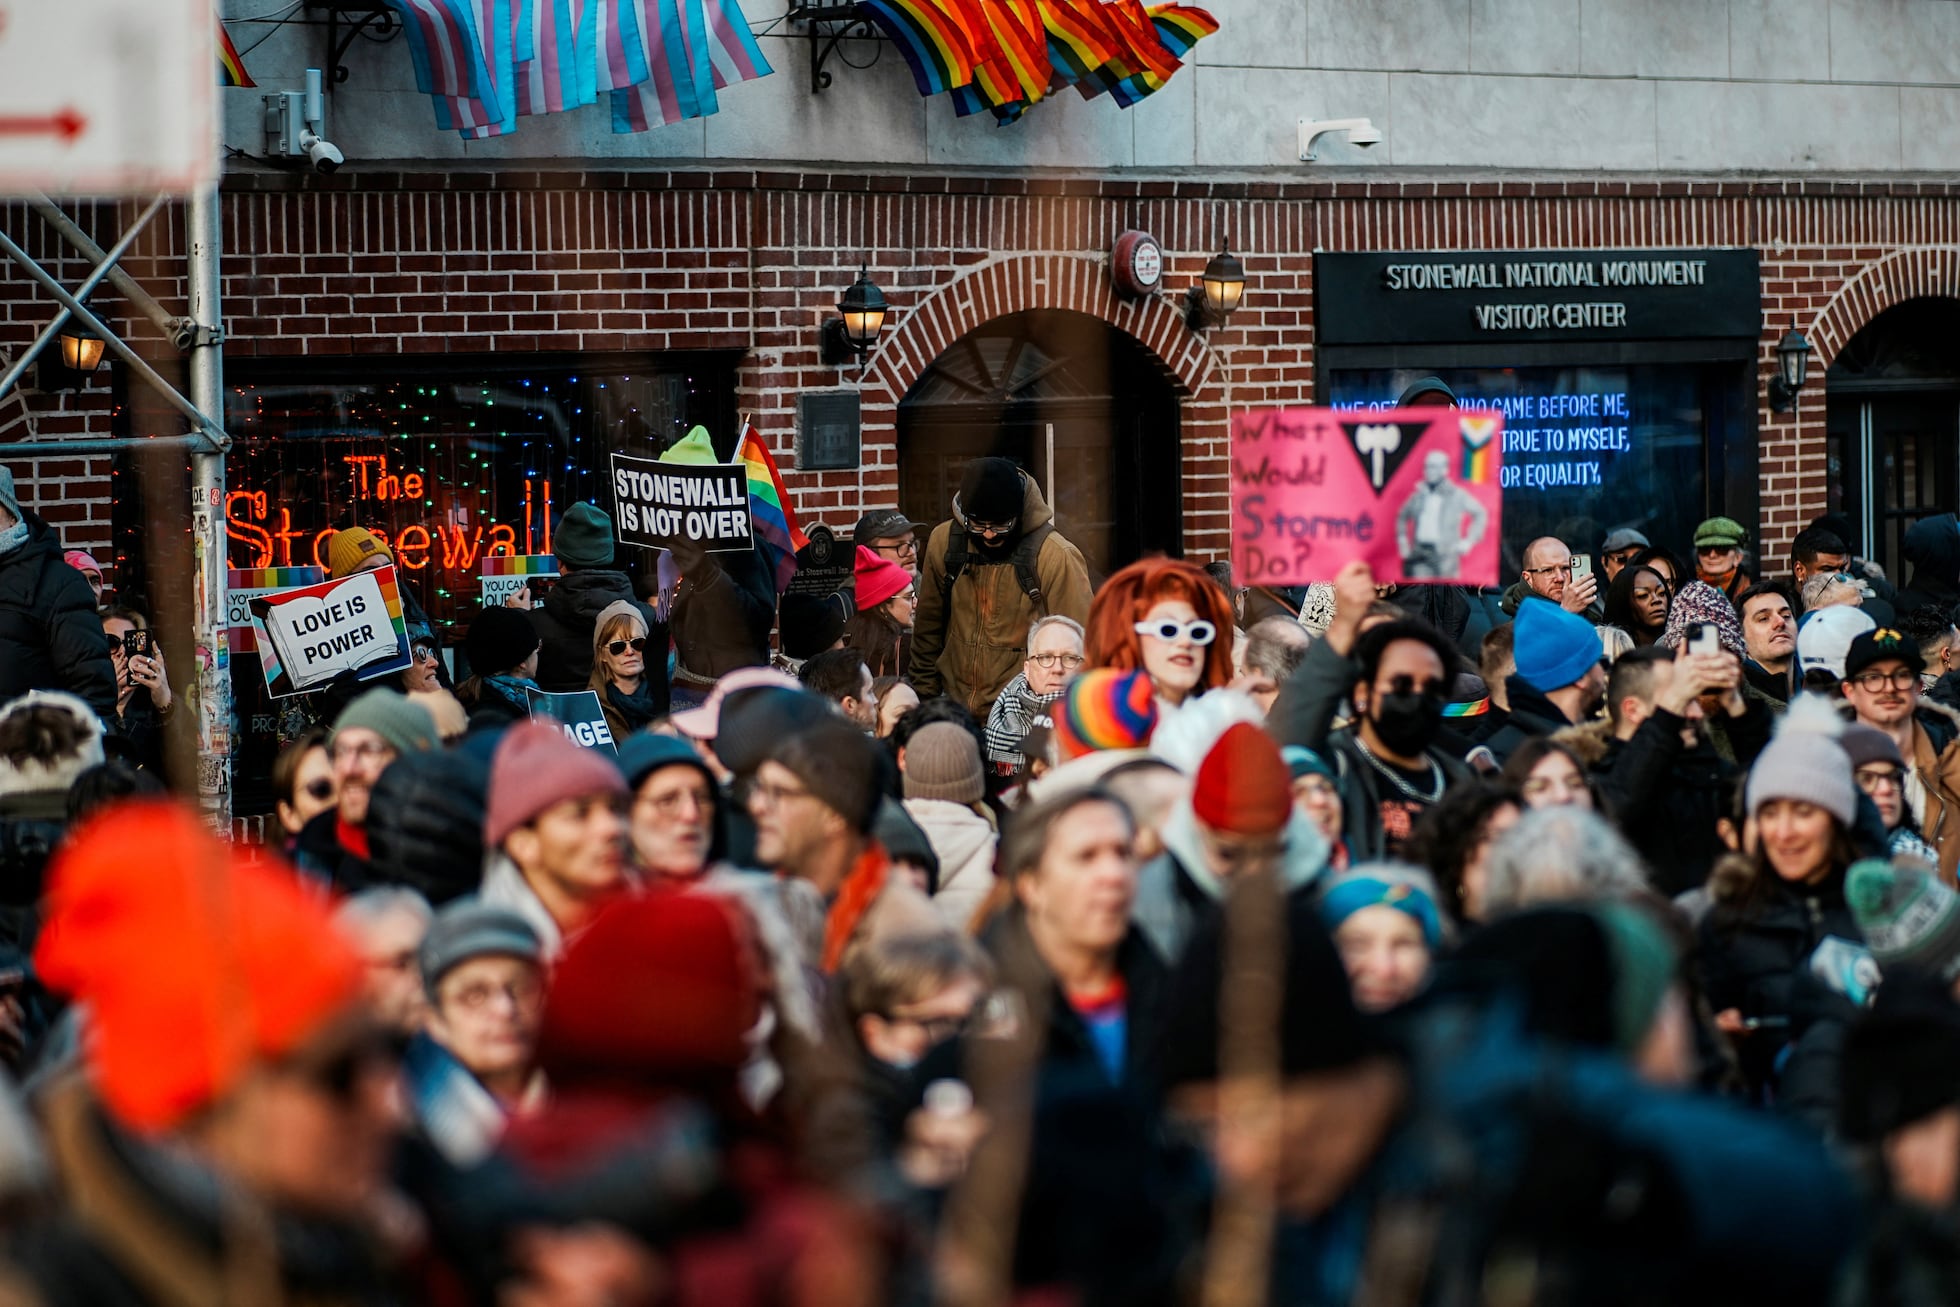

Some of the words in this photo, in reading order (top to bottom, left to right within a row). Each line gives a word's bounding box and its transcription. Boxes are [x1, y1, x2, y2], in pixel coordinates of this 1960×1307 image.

[1387, 263, 1502, 289] STONEWALL
[1506, 262, 1599, 288] NATIONAL
[1602, 260, 1707, 287] MONUMENT
[1476, 304, 1549, 330] VISITOR
[1552, 302, 1626, 329] CENTER
[1539, 394, 1598, 418] BEFORE
[1603, 393, 1629, 419] ME,
[1235, 415, 1330, 443] What
[1499, 428, 1540, 452] TRUE
[1543, 428, 1560, 451] TO
[1568, 426, 1630, 452] MYSELF,
[343, 454, 424, 500] The
[1234, 455, 1327, 486] Would
[616, 468, 745, 507] STONEWALL
[620, 501, 639, 532] IS
[642, 506, 682, 537] NOT
[686, 510, 749, 541] OVER
[1244, 541, 1311, 580] Do?
[485, 580, 504, 592] YOU
[291, 603, 345, 637] LOVE
[345, 595, 366, 617] IS
[303, 624, 375, 664] POWER
